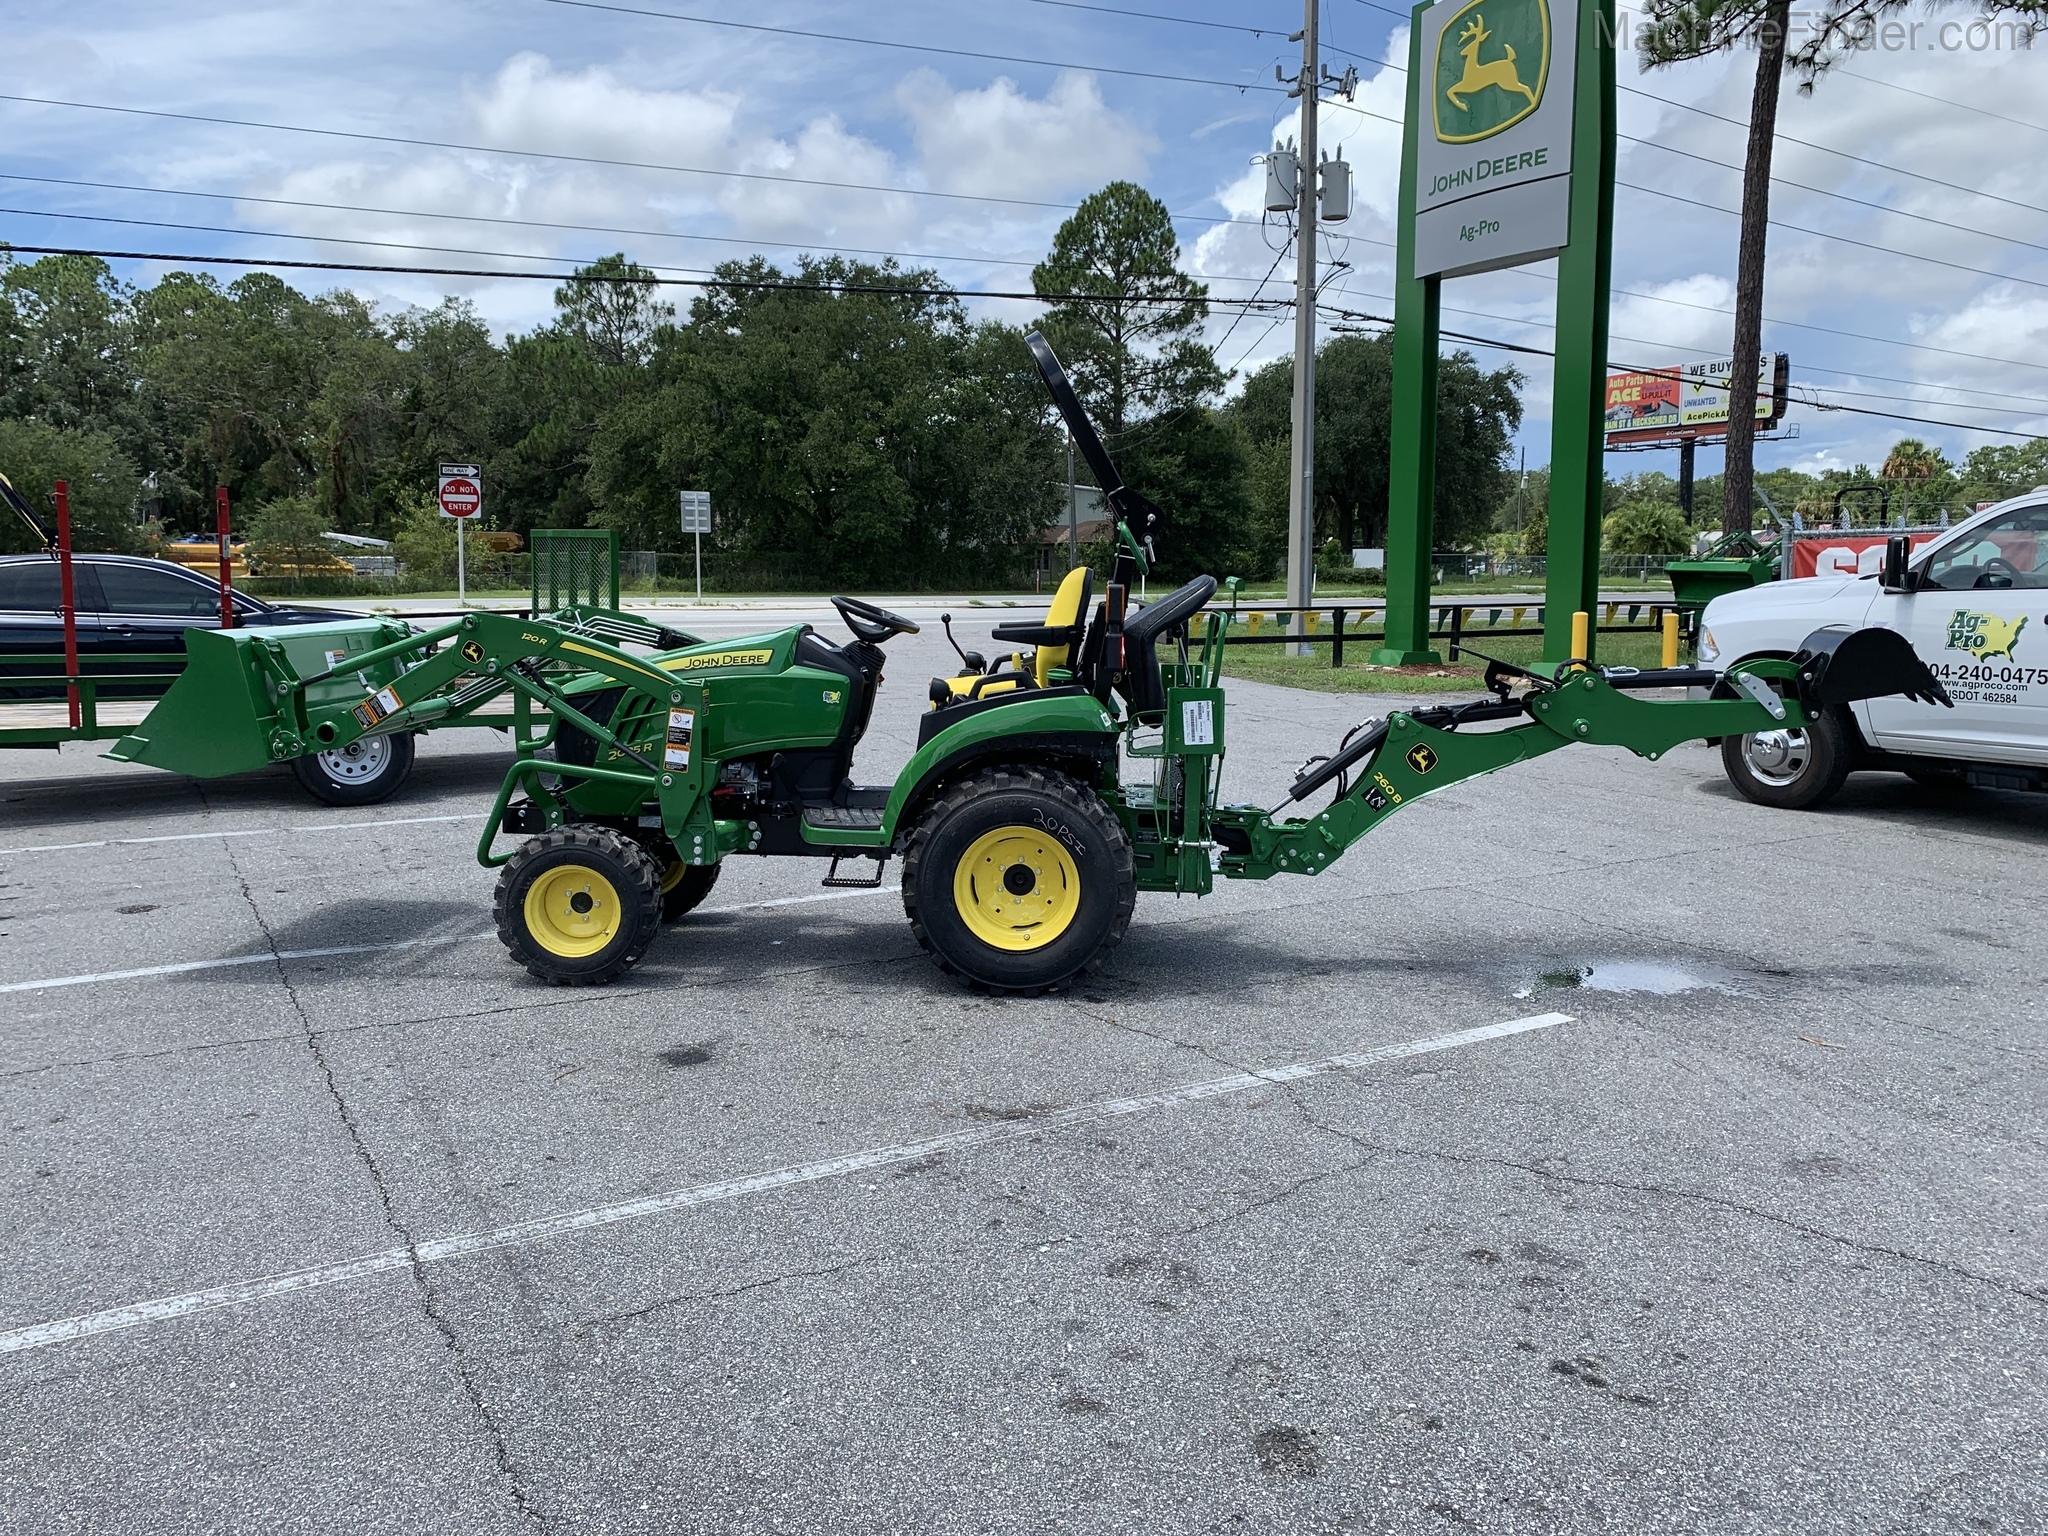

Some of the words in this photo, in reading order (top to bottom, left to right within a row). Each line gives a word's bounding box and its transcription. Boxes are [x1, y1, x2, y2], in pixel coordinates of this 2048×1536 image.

[1428, 166, 1473, 196] JOHN
[1476, 147, 1548, 180] DEERE
[1459, 219, 1500, 241] Ag-Pro
[1690, 365, 1706, 376] WE
[1710, 361, 1733, 374] BUY
[1609, 377, 1625, 389] Auto
[1626, 375, 1644, 386] Parts
[1609, 387, 1641, 404] ACE
[1684, 396, 1717, 407] UNWANTED
[1619, 419, 1626, 428] ST
[1669, 414, 1677, 423] DR
[460, 486, 475, 494] NOT
[448, 503, 472, 511] ENTER
[1946, 629, 1987, 649] Pro
[684, 658, 720, 669] JOHN
[722, 655, 764, 665] DEERE
[1930, 663, 2048, 685] 04-240-0475
[1982, 692, 2017, 704] 462584
[1373, 771, 1395, 795] 260
